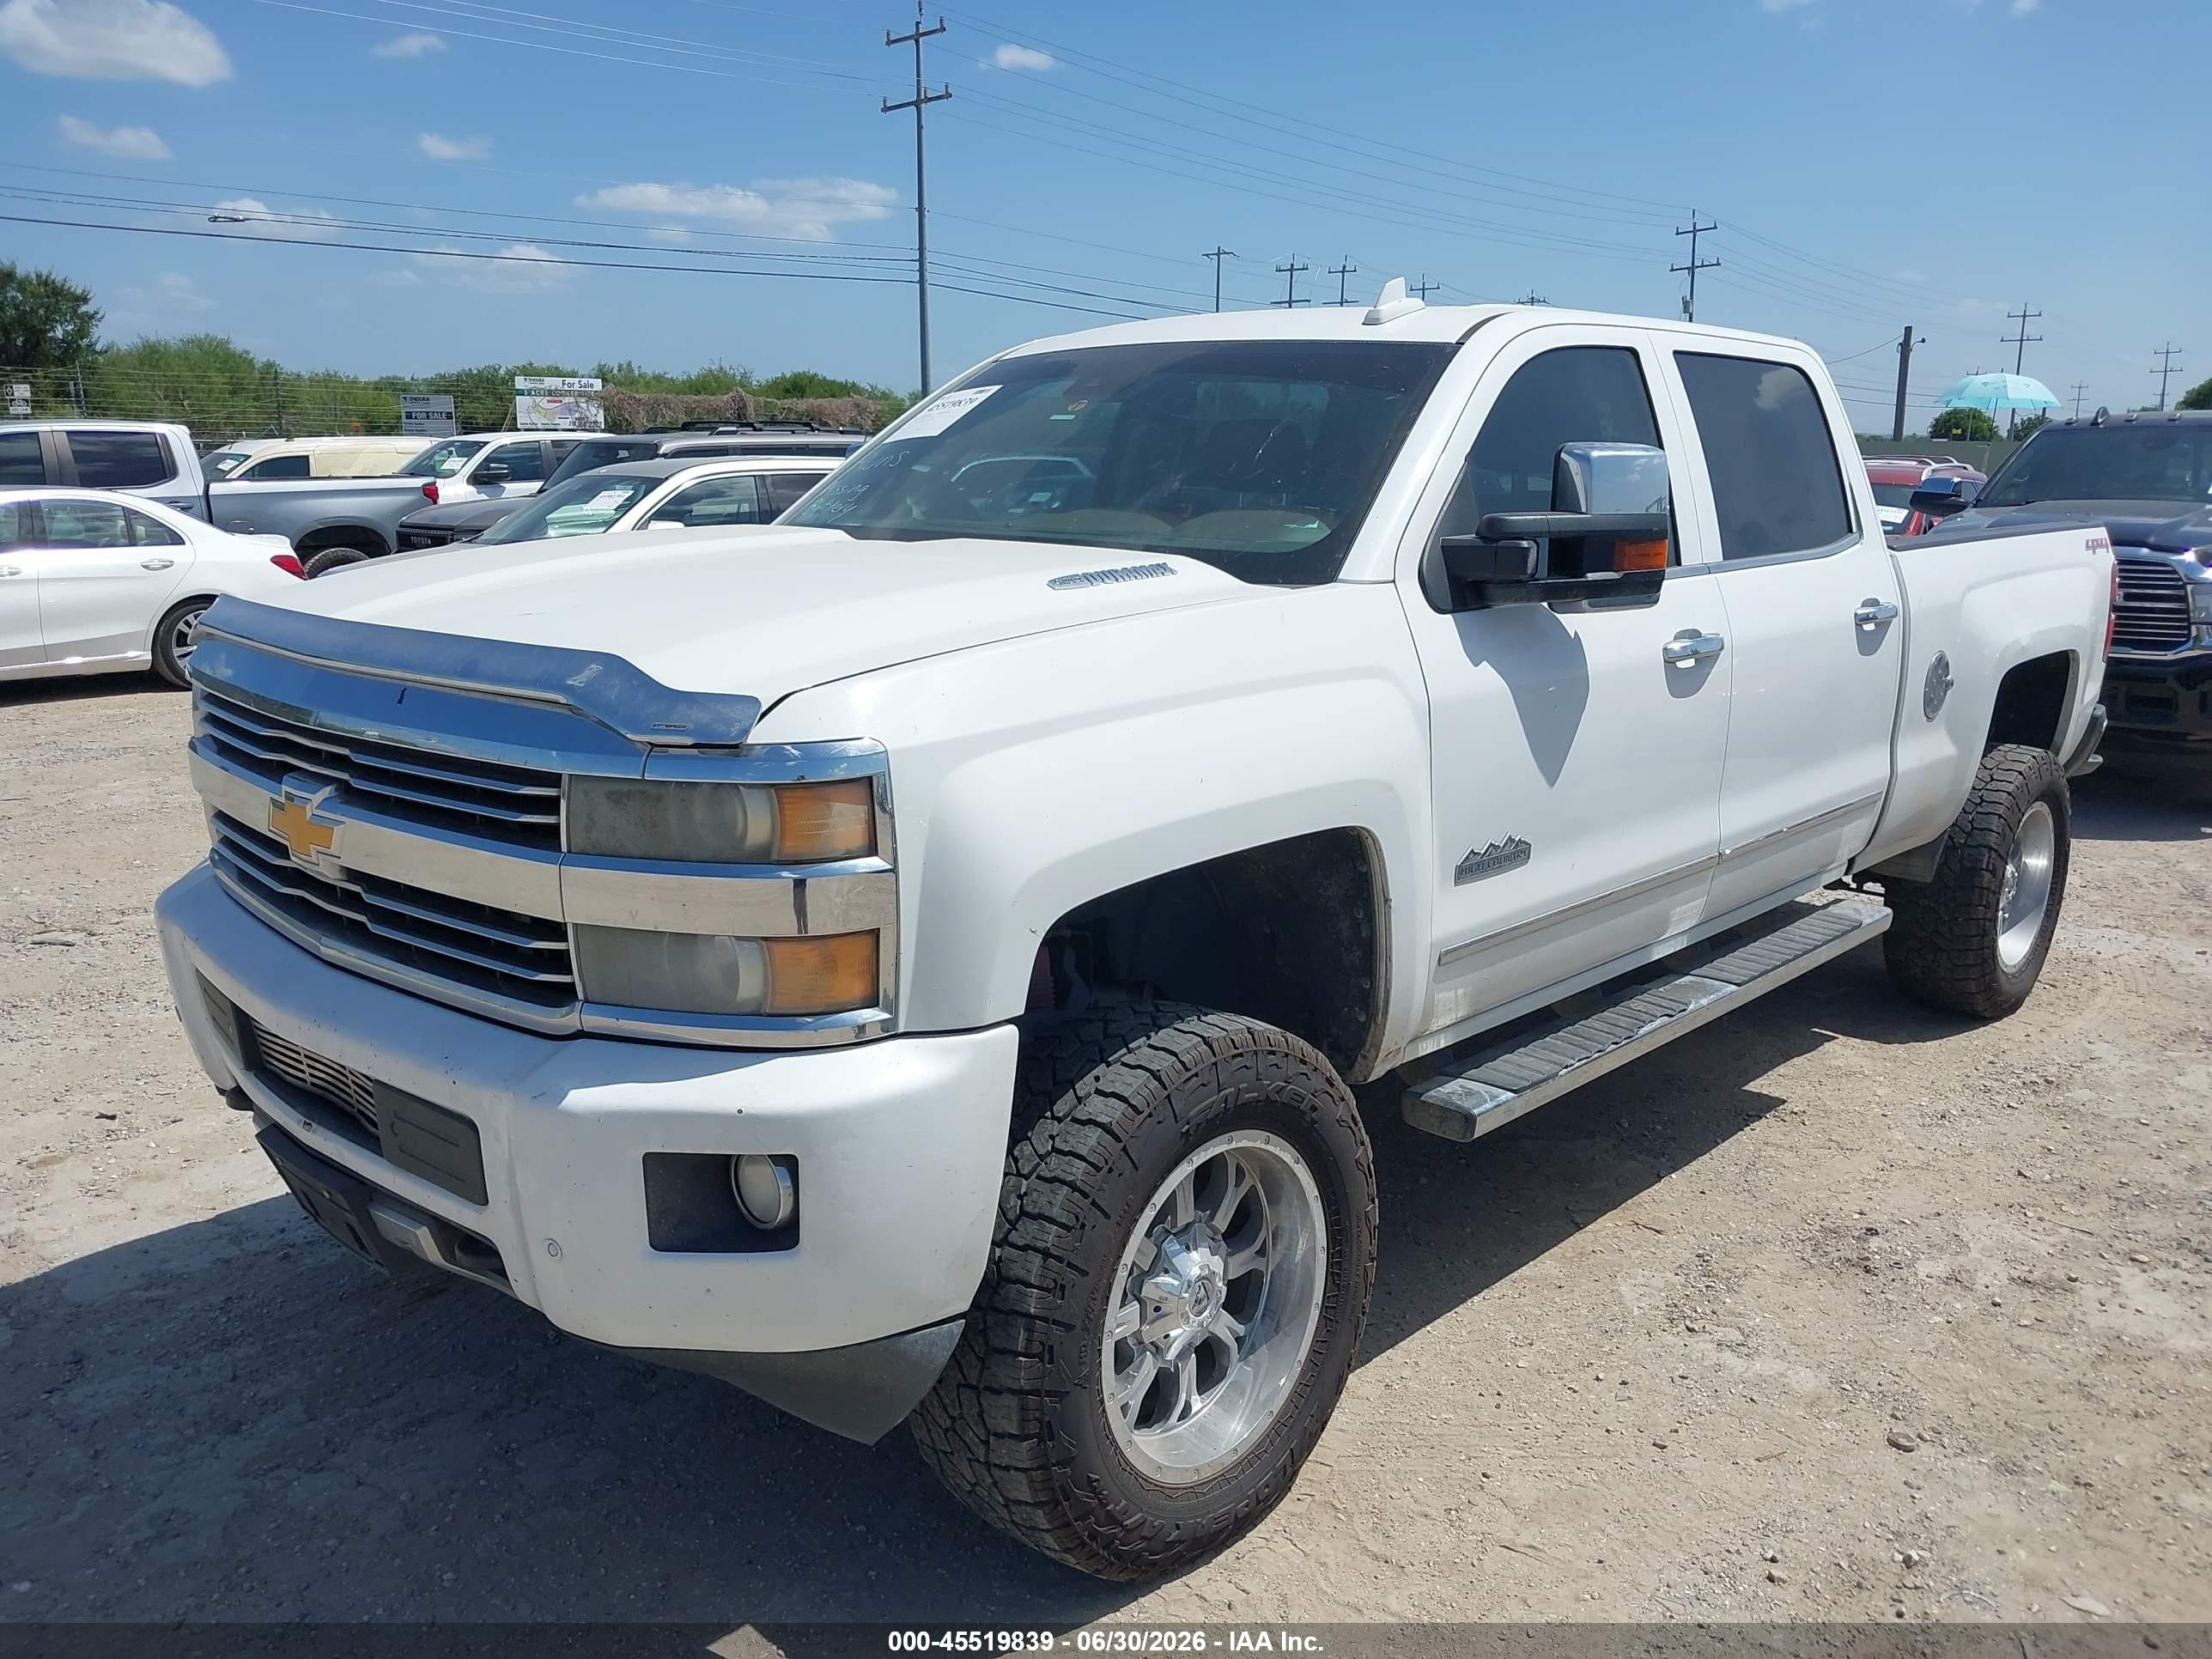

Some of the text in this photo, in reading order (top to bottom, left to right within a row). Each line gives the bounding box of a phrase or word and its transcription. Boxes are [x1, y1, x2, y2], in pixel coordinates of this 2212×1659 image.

[562, 380, 594, 389] For Sale
[410, 536, 432, 545] TOYOTA
[1083, 562, 1178, 586] DURAMAX
[1461, 850, 1527, 875] HIGH COUNTRY
